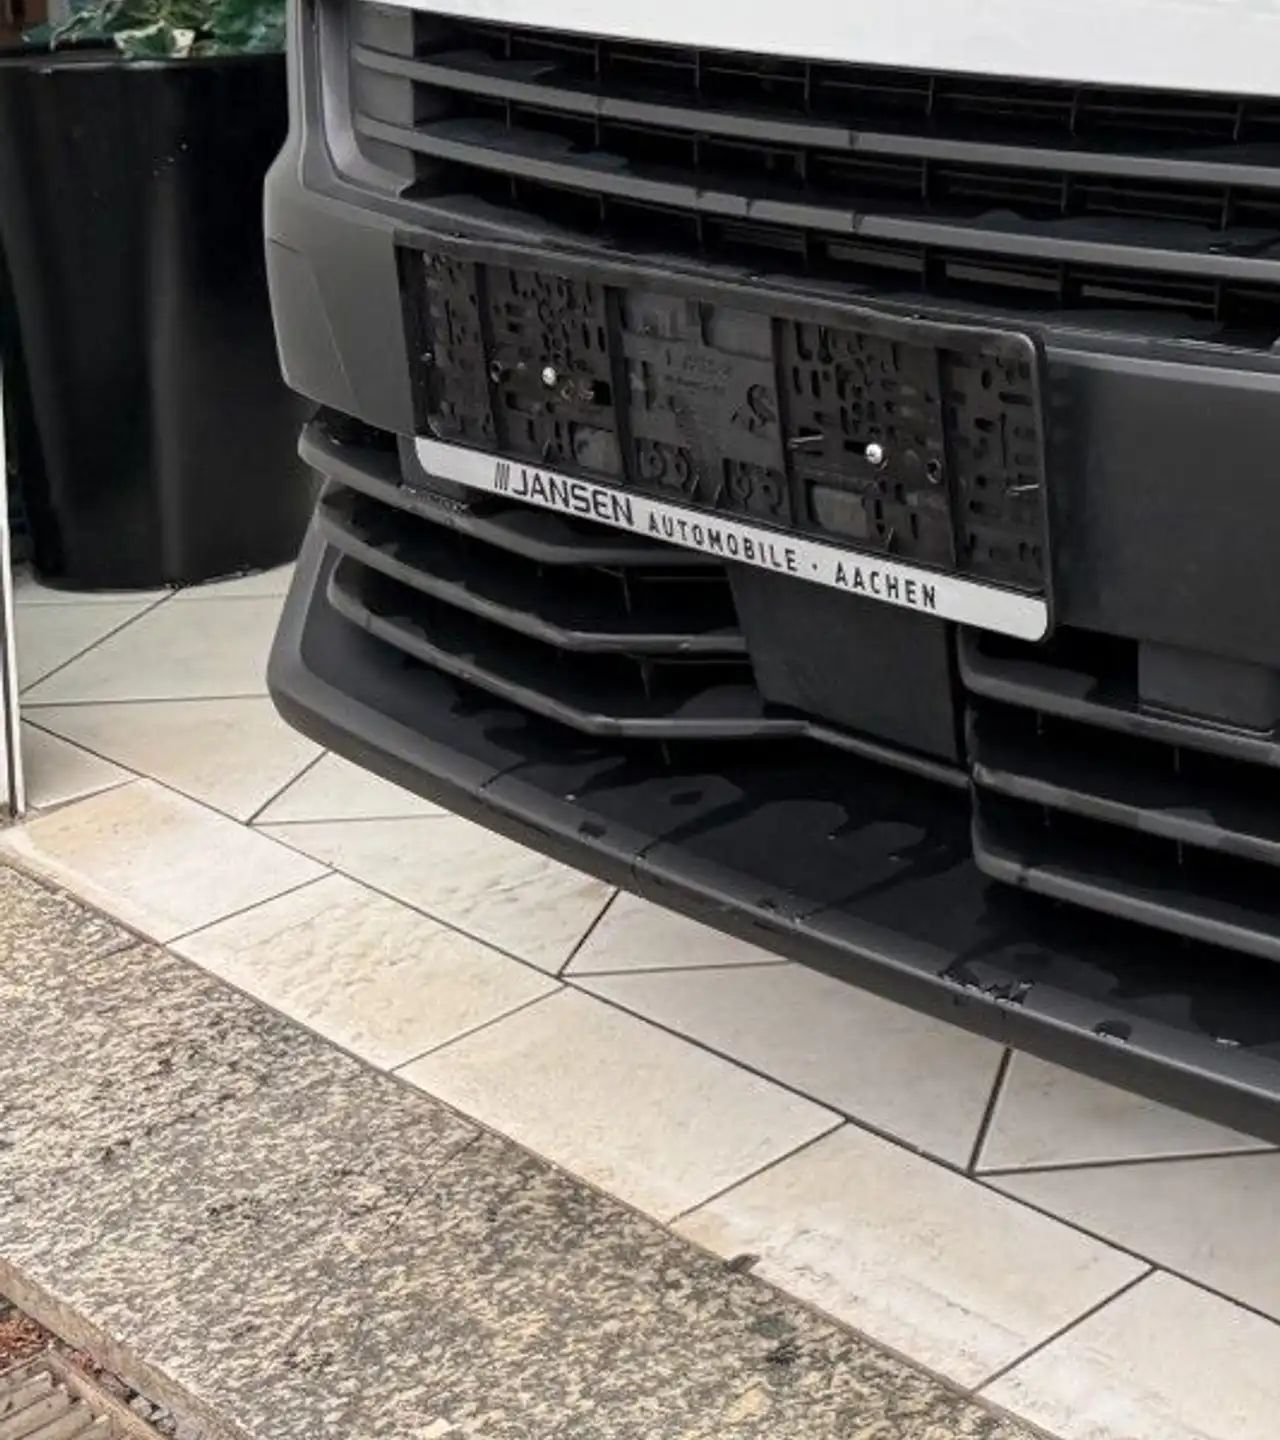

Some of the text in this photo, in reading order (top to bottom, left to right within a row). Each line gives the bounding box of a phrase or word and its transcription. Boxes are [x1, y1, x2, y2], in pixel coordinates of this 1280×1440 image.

[510, 468, 937, 610] JANSEN AUTOMOBILE AACHEN
